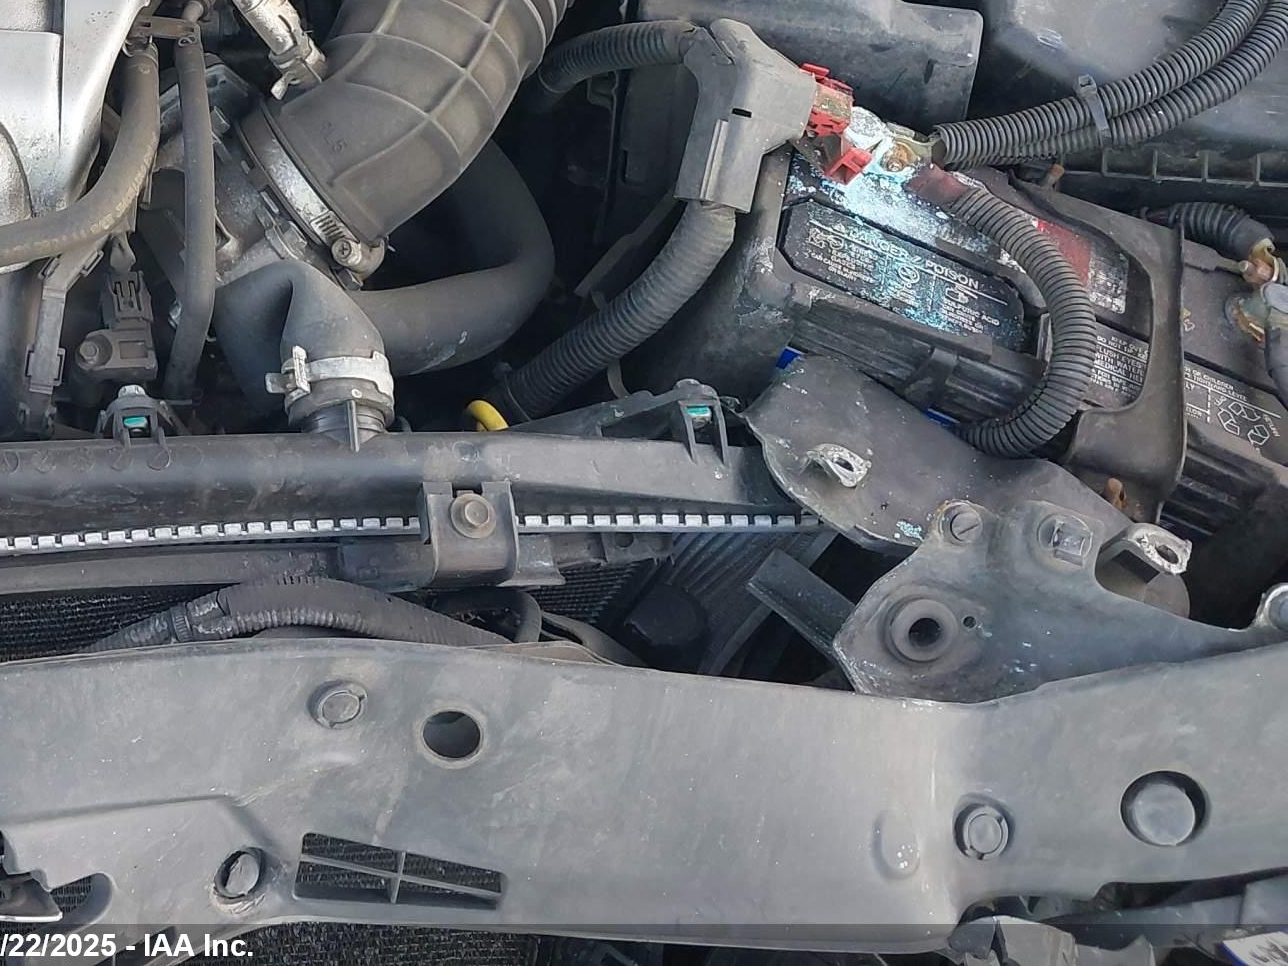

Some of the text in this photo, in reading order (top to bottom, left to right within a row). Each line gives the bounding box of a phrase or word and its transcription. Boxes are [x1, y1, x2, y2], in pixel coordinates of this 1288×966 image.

[925, 260, 979, 290] POISON
[981, 314, 1000, 326] ACID
[1097, 335, 1107, 343] DO
[1108, 340, 1121, 350] NOT
[1094, 352, 1114, 364] WITH
[1093, 359, 1127, 376] MEDICAL
